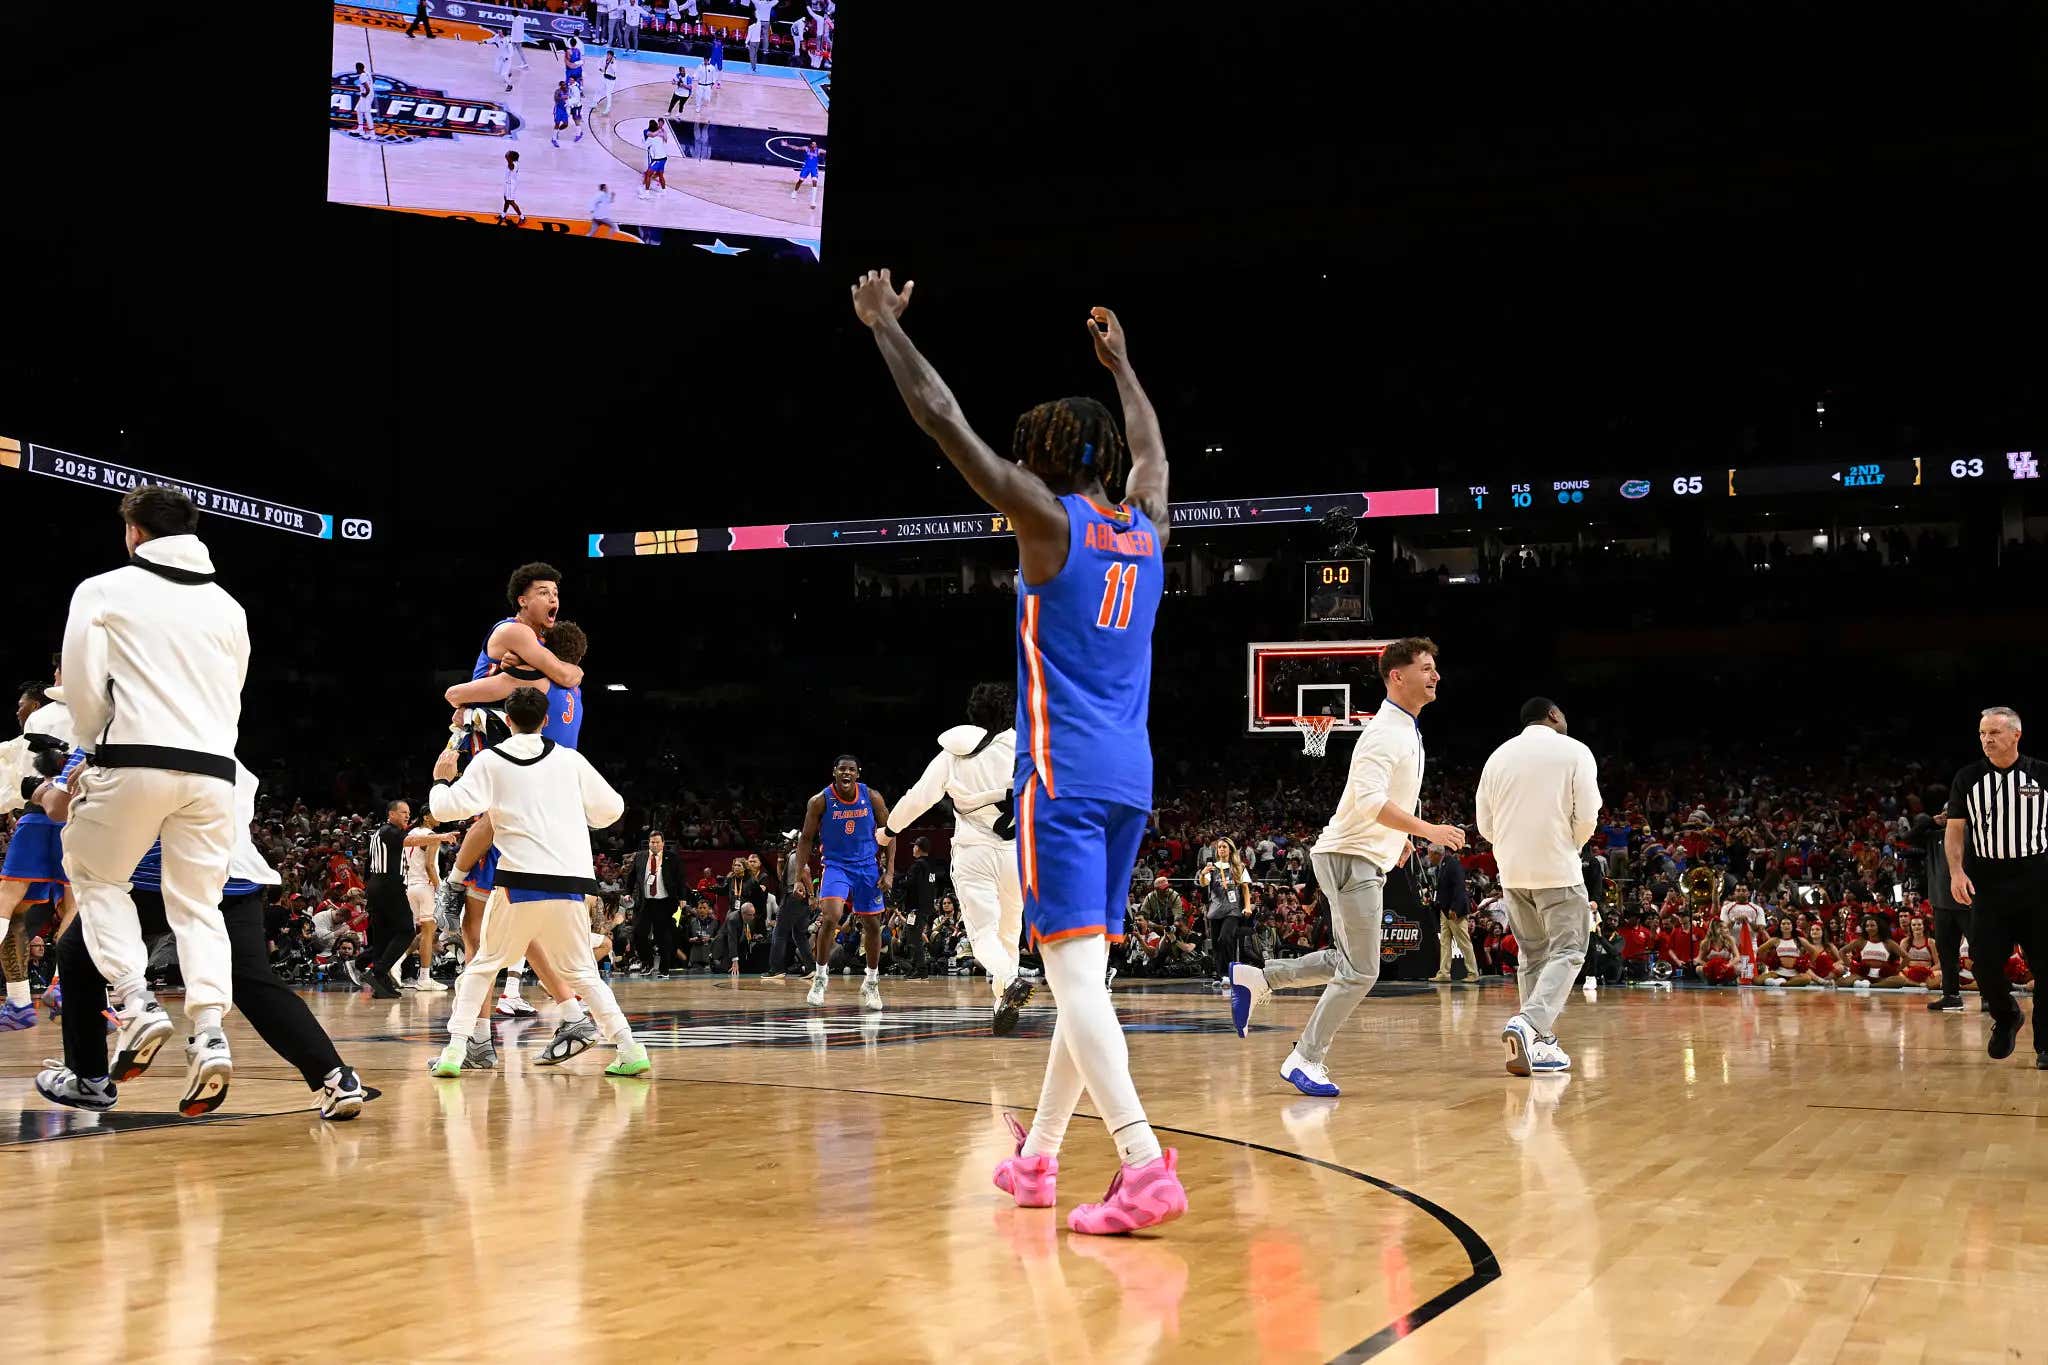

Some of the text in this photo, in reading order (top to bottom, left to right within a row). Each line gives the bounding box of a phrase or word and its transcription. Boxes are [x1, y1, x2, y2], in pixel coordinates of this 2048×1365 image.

[478, 10, 541, 25] FLORDA
[386, 100, 508, 126] FOUR
[1850, 464, 1880, 476] 2ND
[1950, 458, 1984, 478] 63
[1511, 484, 1531, 493] FLS
[1553, 480, 1590, 491] BONUS
[1672, 476, 1703, 494] 65
[1844, 474, 1886, 487] HALF
[54, 458, 97, 480] 2025
[103, 468, 149, 488] NCAA
[212, 493, 259, 518] FINAL
[264, 506, 304, 529] FOUR
[1469, 486, 1489, 496] TOL
[1474, 495, 1483, 510] 1
[1511, 492, 1532, 508] 10
[1227, 506, 1241, 519] TX
[343, 521, 371, 538] CC
[897, 524, 921, 537] 2025
[924, 522, 950, 535] NCAA
[953, 520, 983, 534] MEN'S
[1085, 522, 1154, 557] ABEEEN
[1322, 566, 1349, 584] 0.0
[1096, 561, 1138, 630] 11
[561, 691, 575, 724] 3
[1390, 928, 1419, 940] FOUR
